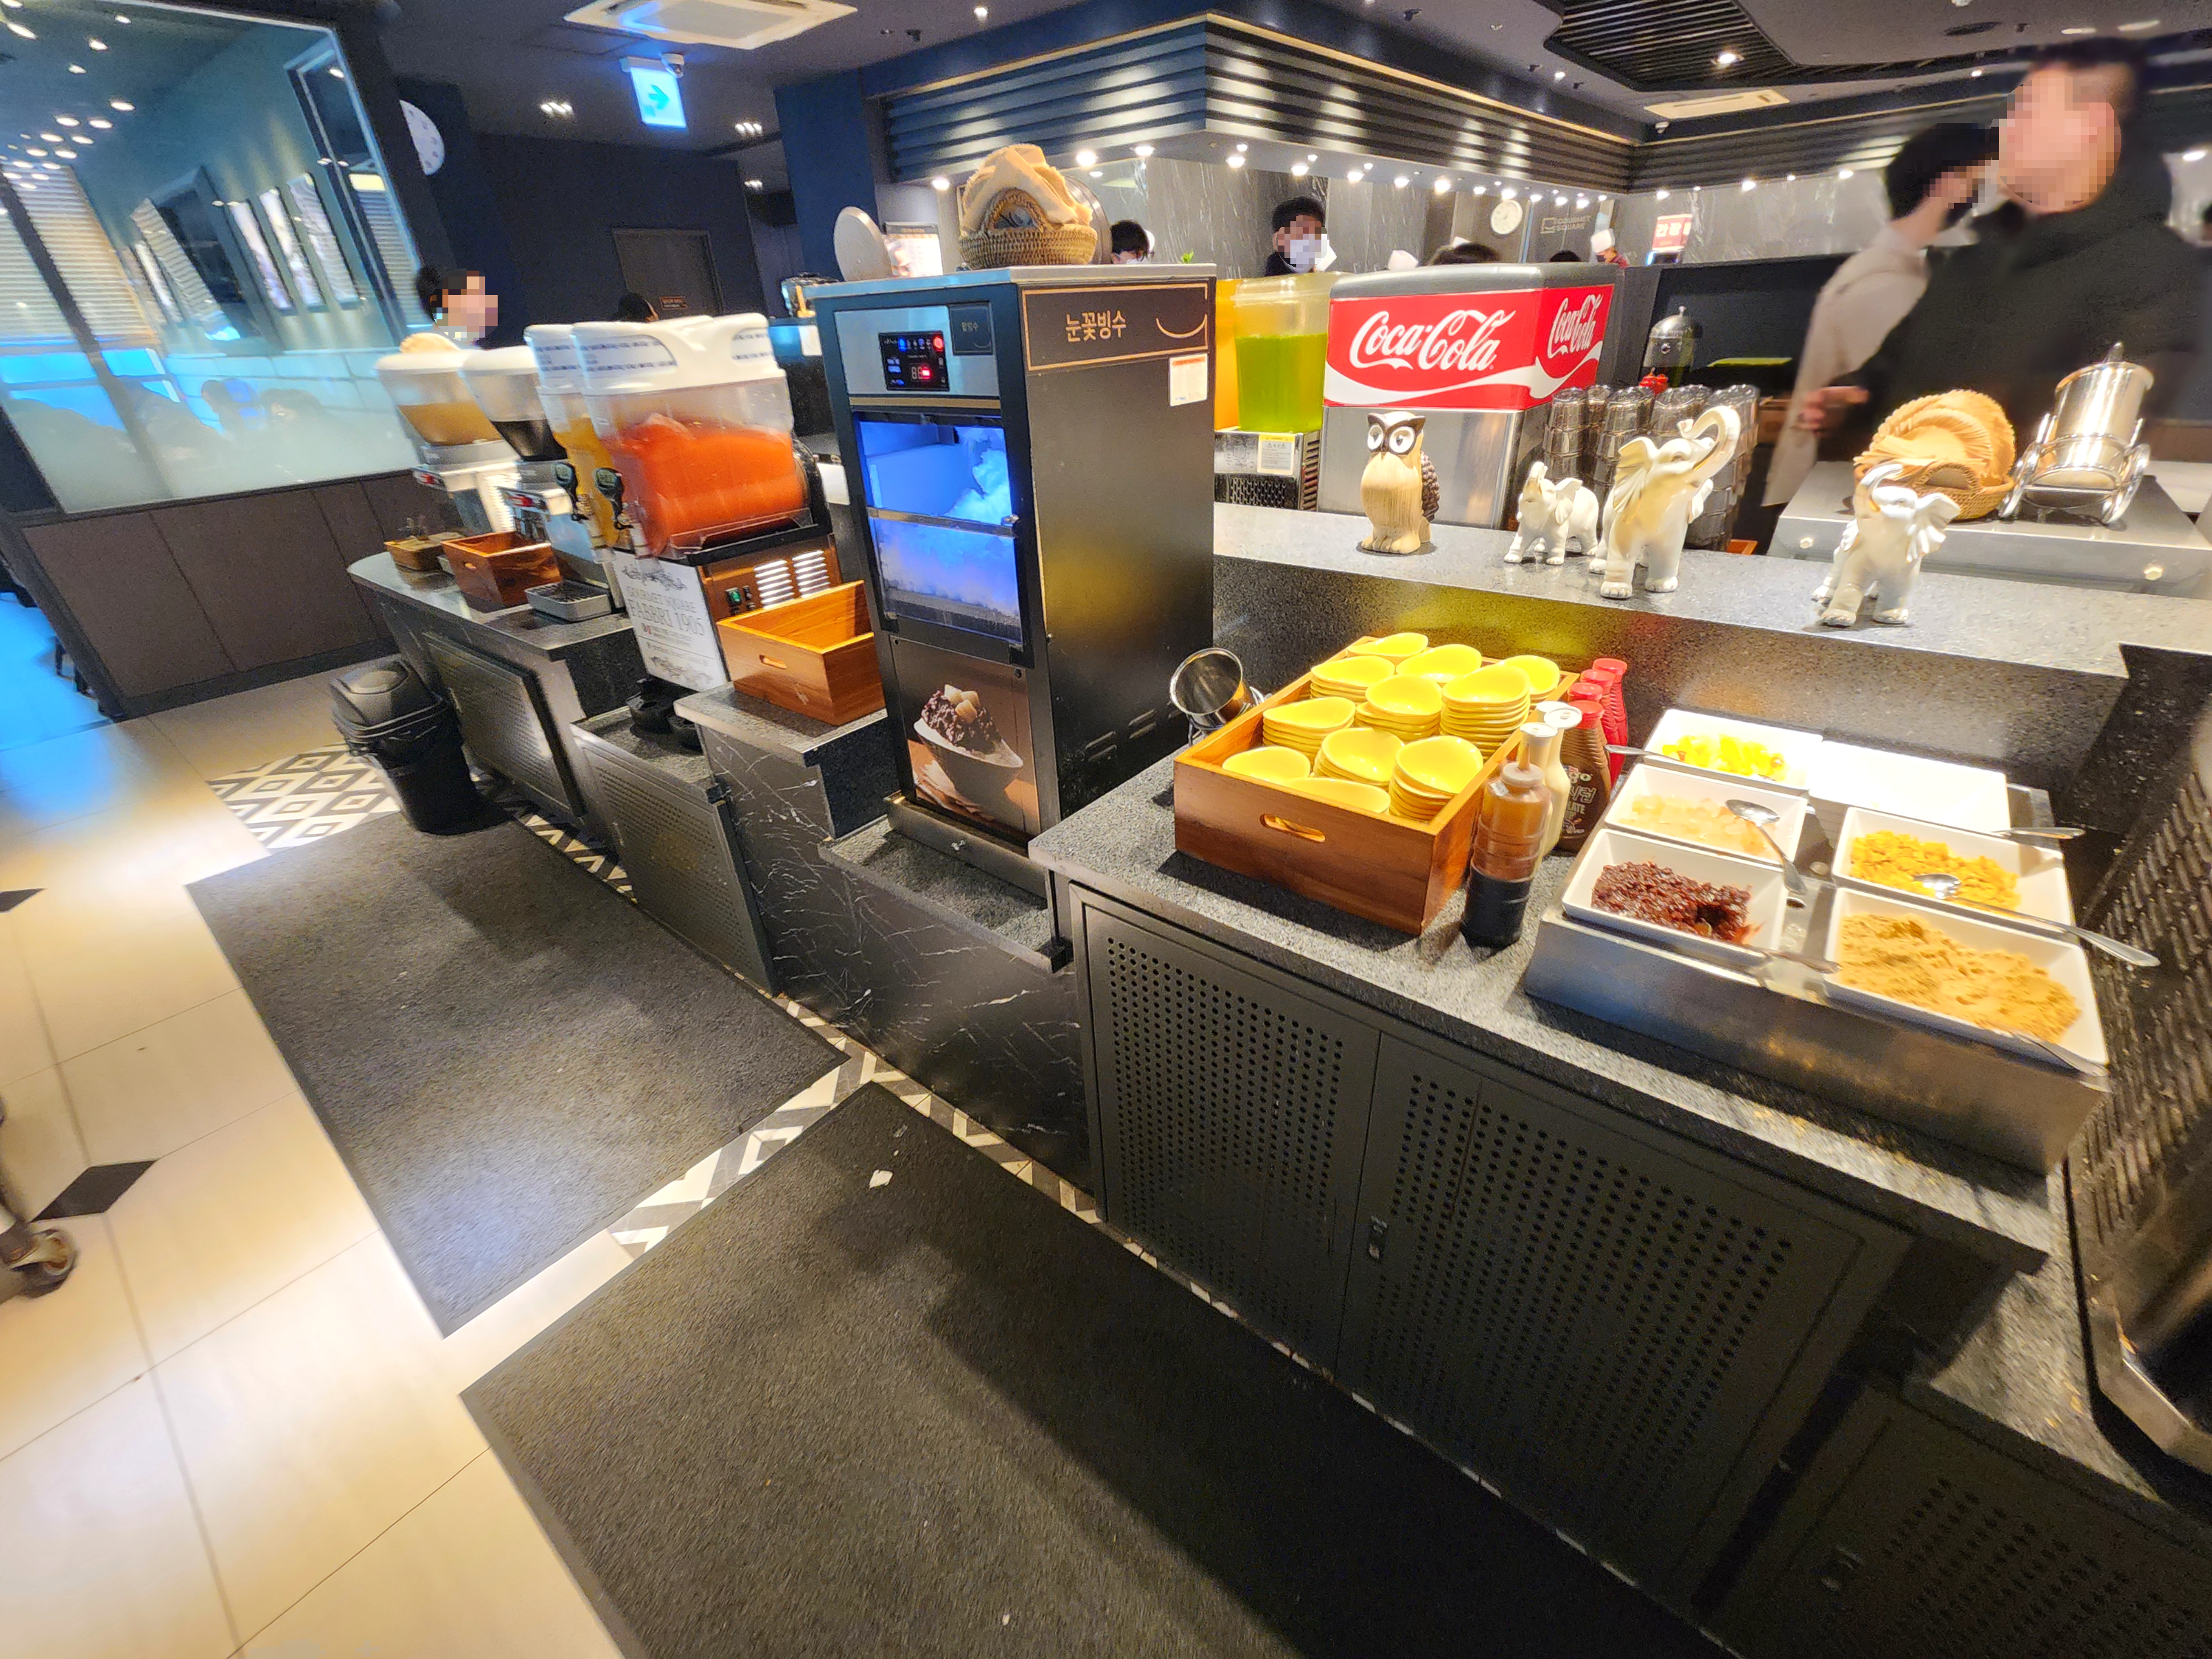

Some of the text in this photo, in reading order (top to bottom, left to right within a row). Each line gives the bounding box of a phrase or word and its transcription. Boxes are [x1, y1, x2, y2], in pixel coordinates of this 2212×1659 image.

[1065, 310, 1127, 343] 눈꽃빙수
[1349, 310, 1516, 371] Coca-Cola
[1548, 293, 1604, 359] Coca-Cola
